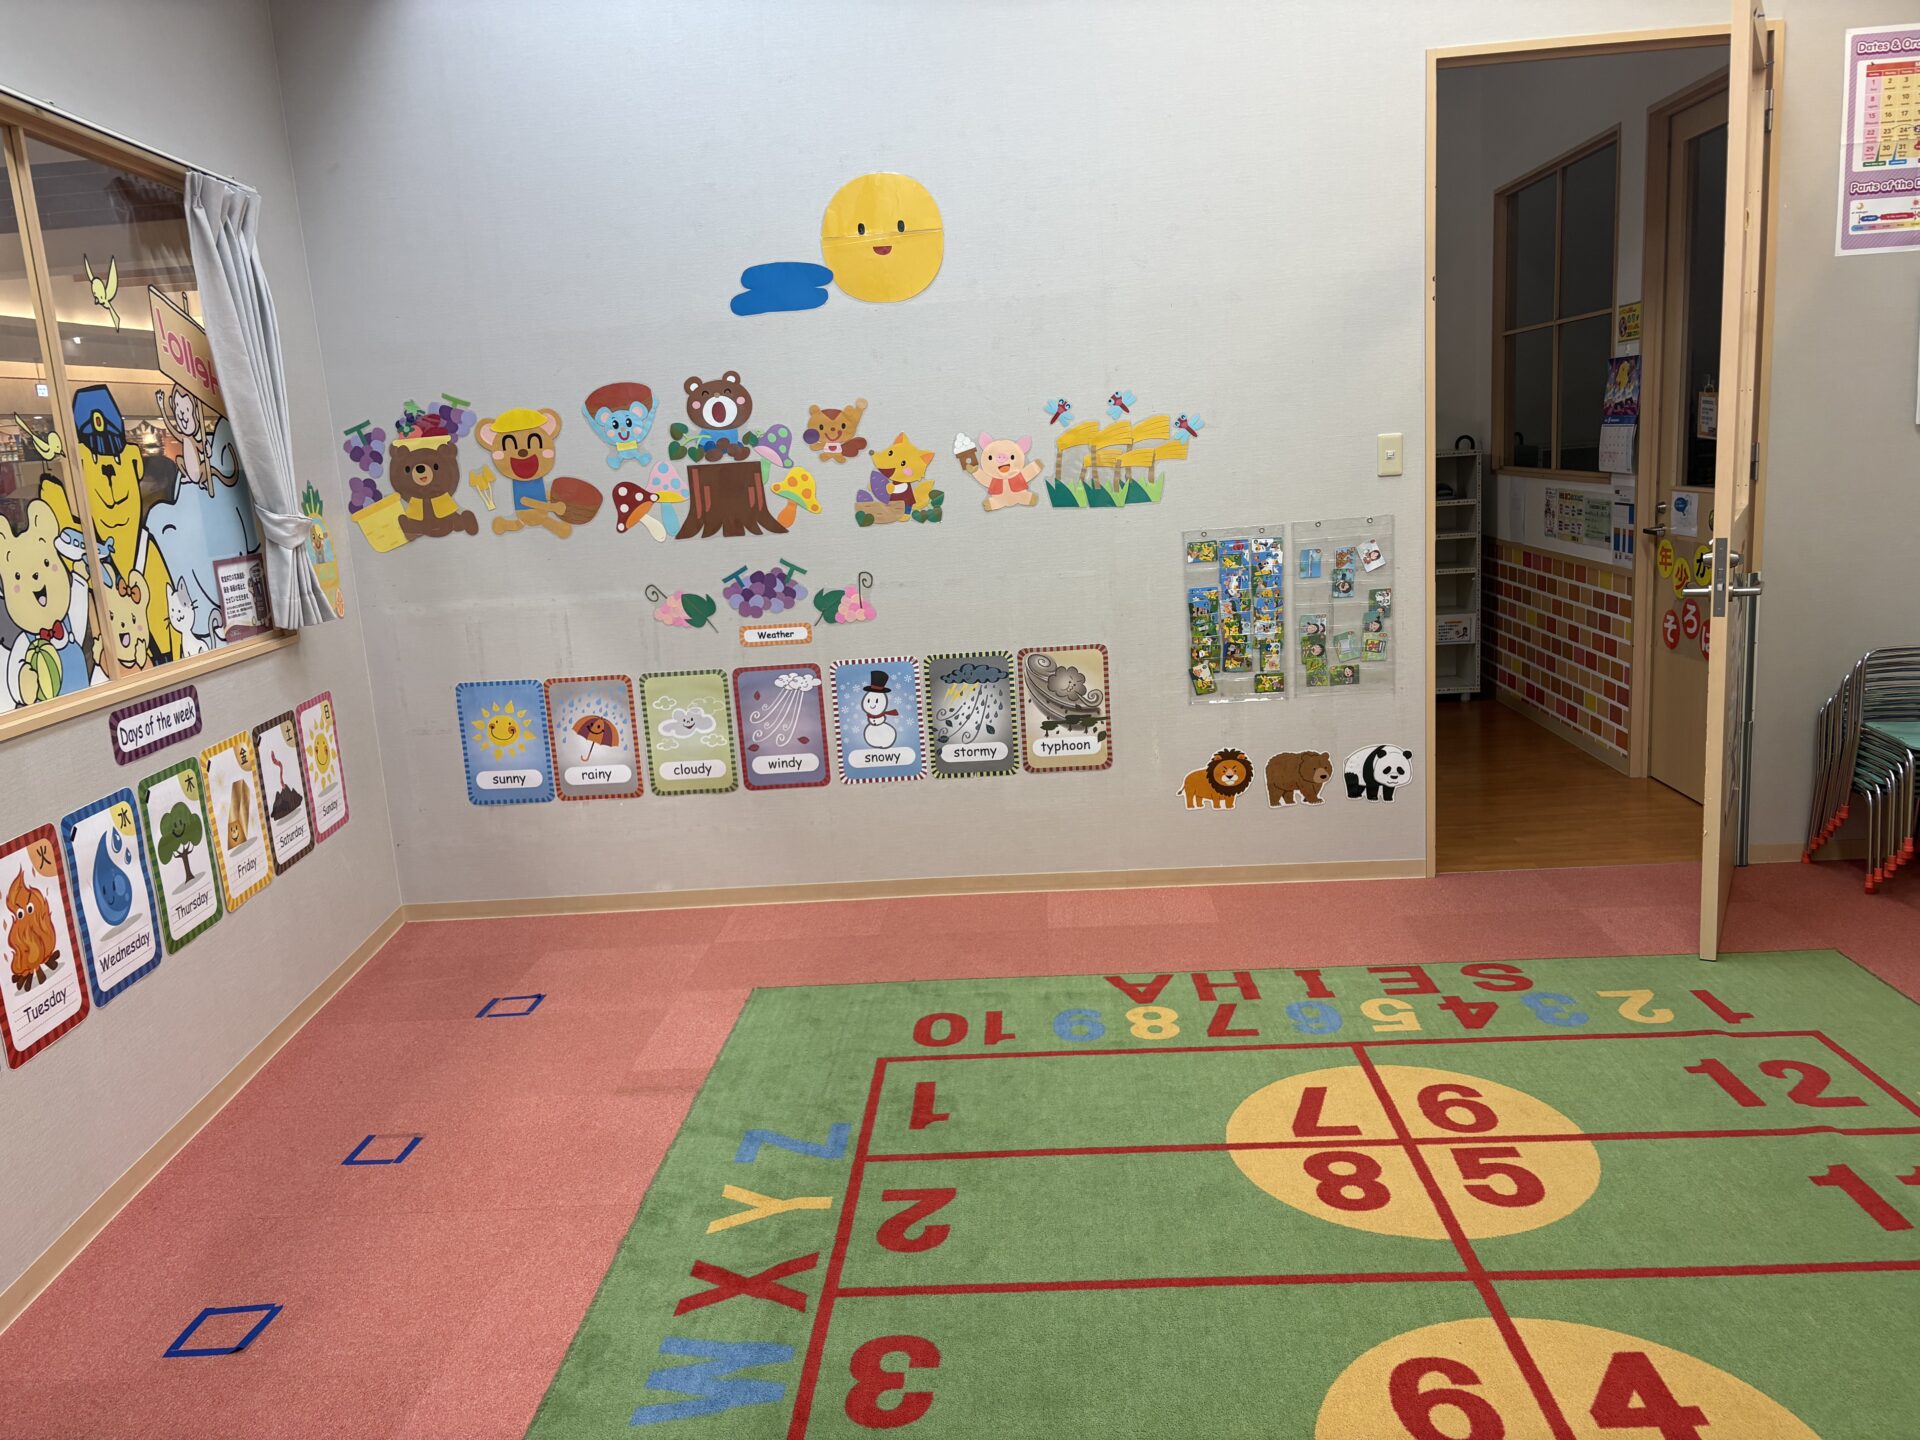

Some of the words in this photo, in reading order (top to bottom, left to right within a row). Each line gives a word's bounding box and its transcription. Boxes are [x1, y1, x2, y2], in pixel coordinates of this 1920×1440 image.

[1858, 42, 1889, 53] Dates
[1892, 39, 1901, 50] &
[1851, 182, 1880, 193] Parts
[1881, 180, 1894, 192] of
[1895, 179, 1914, 190] the
[757, 629, 794, 640] Weather
[119, 724, 144, 746] Days
[145, 715, 155, 735] of
[156, 711, 172, 731] the
[173, 702, 195, 725] week
[324, 704, 331, 721] 日
[284, 725, 293, 743] 土
[1040, 739, 1091, 753] typhoon
[238, 747, 249, 766] 金
[768, 756, 803, 771] windy
[864, 751, 901, 765] snowy
[953, 745, 997, 760] stormy
[184, 774, 196, 793] 木
[492, 773, 526, 787] sunny
[581, 768, 612, 782] rainy
[673, 763, 712, 778] cloudy
[117, 807, 132, 829] 水
[322, 800, 338, 817] Sunday
[279, 824, 304, 849] Saturday
[36, 845, 51, 870] 火
[237, 856, 257, 878] Friday
[175, 890, 209, 920] Thursday
[99, 930, 150, 973] Wednesday
[23, 986, 67, 1024] Tuesday
[1207, 1003, 1260, 1037] 7
[1360, 997, 1422, 1032] 5
[1438, 996, 1500, 1030] 4
[1519, 991, 1590, 1027] 3
[1597, 989, 1675, 1024] 2
[1691, 990, 1753, 1024] 1
[912, 1011, 1016, 1047] 10
[1125, 1005, 1181, 1040] 8
[1683, 1058, 1868, 1108] 12
[909, 1081, 950, 1131] 1
[1292, 1087, 1362, 1138] 7
[1302, 1150, 1391, 1212] 8
[1449, 1146, 1545, 1208] 5
[1808, 1164, 1920, 1231] 1
[876, 1188, 957, 1253] 2
[844, 1335, 941, 1429] 3
[1589, 1351, 1710, 1440] 4
